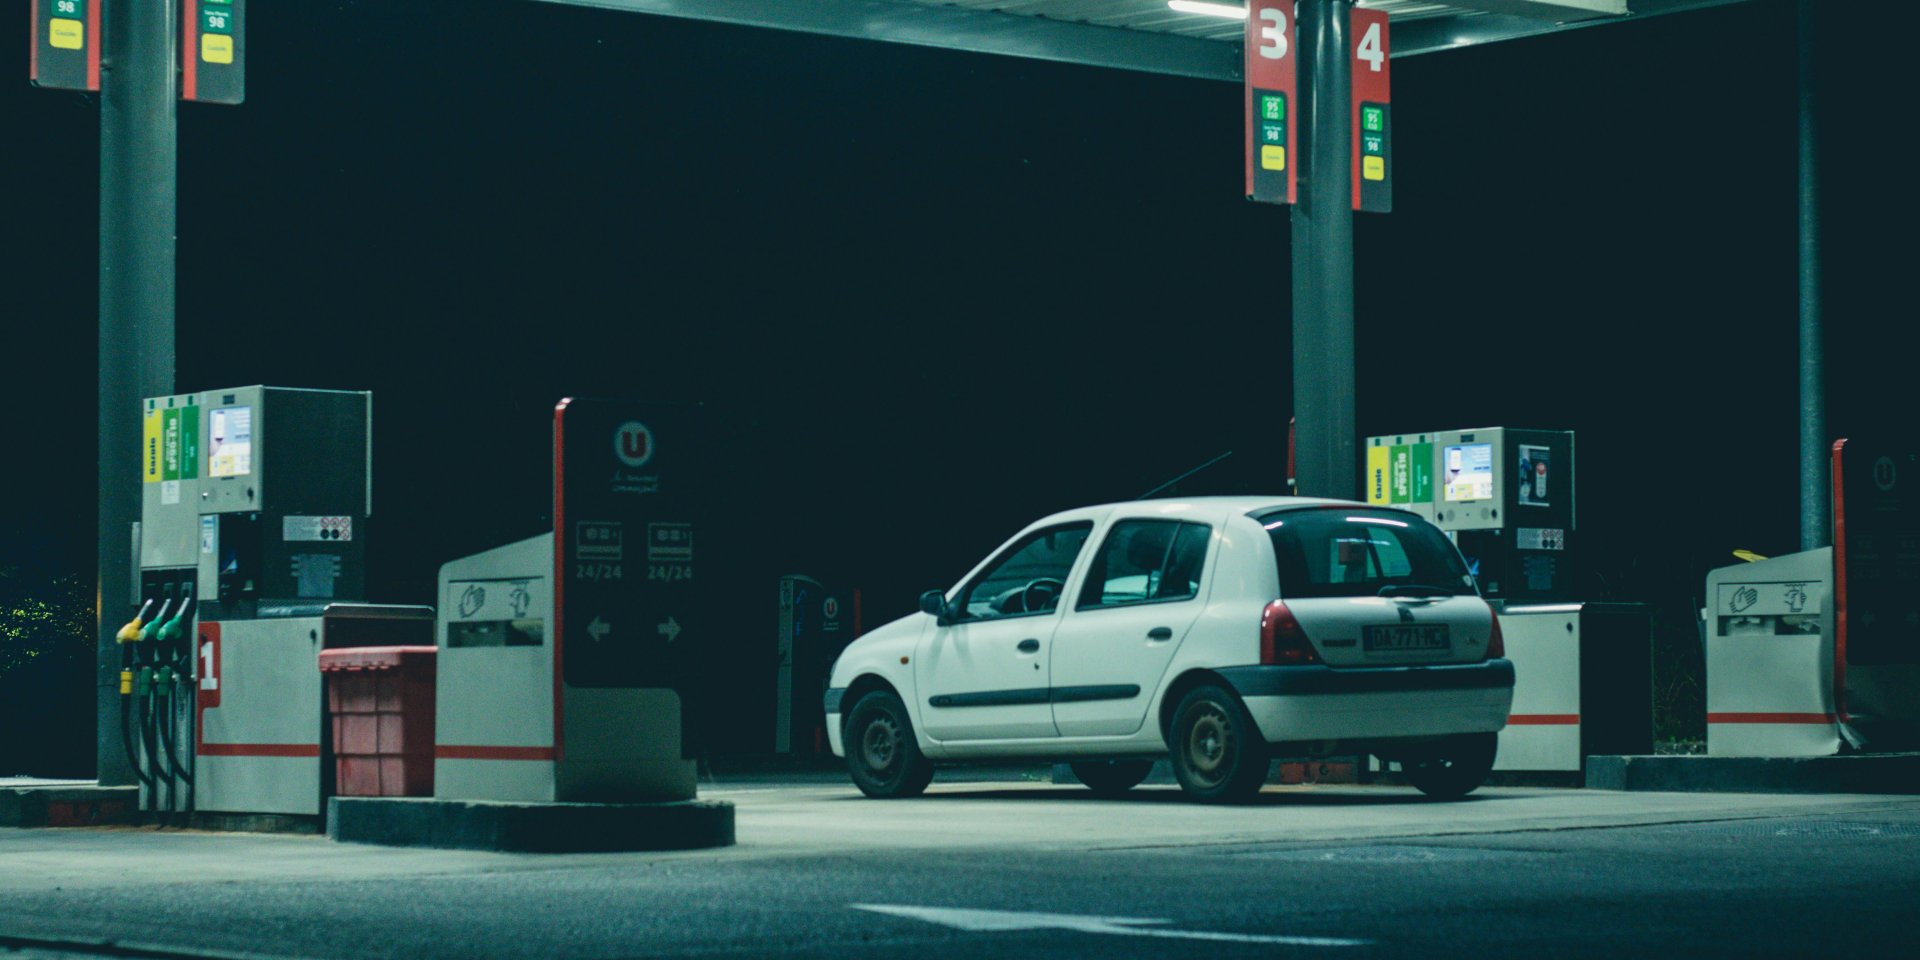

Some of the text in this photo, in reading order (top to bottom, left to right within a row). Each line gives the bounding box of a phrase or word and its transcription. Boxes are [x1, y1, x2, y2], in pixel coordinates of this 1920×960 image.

[57, 0, 75, 13] 98
[208, 16, 225, 28] 98
[1259, 8, 1288, 59] 3
[1357, 22, 1384, 72] 4
[1266, 101, 1279, 112] 95
[1367, 112, 1378, 123] 95
[1266, 130, 1279, 140] 98
[1367, 141, 1379, 151] 98
[622, 431, 647, 459] U
[576, 565, 622, 581] 24/24
[648, 566, 692, 582] 24/24
[200, 641, 218, 690] 1
